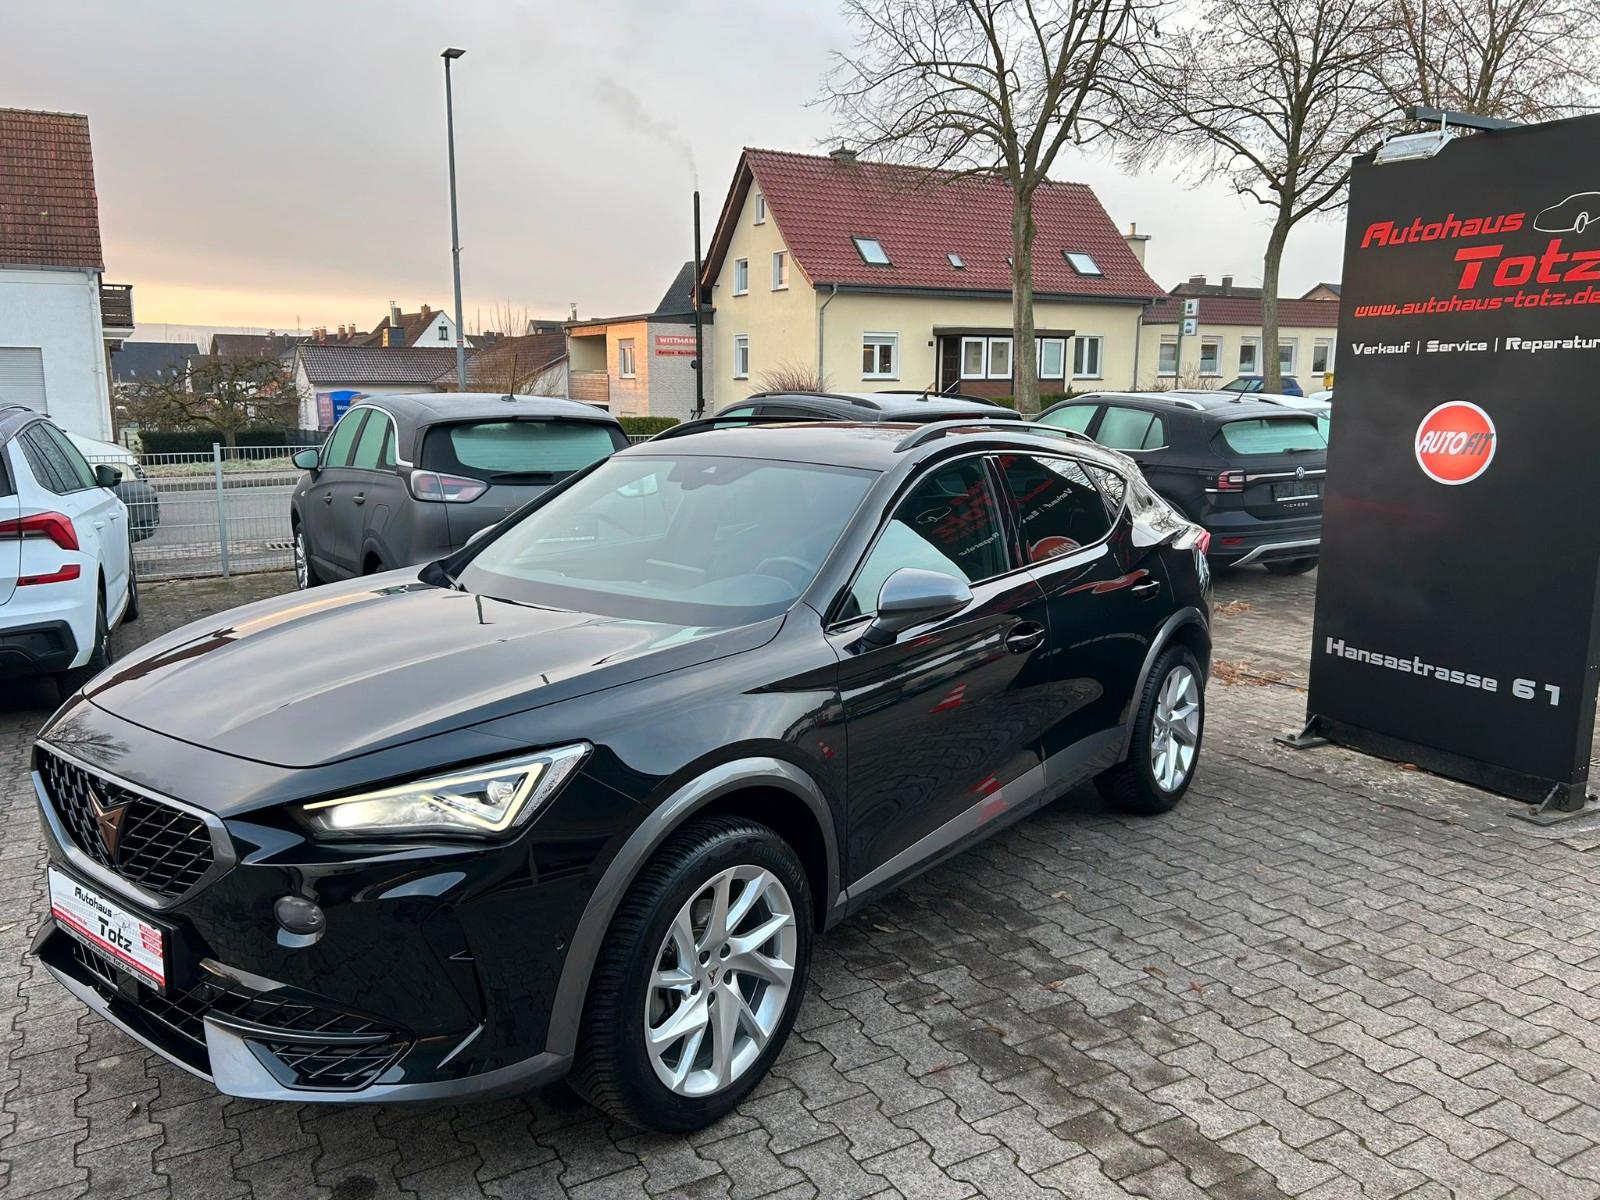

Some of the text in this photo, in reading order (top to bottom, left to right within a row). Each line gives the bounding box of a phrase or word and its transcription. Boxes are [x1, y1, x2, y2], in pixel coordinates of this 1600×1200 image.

[1361, 212, 1525, 248] Autohaus
[1454, 238, 1600, 290] Totz
[1352, 341, 1411, 355] Verkauf
[1426, 339, 1488, 353] Service
[1505, 336, 1600, 353] Reparatur
[1419, 430, 1495, 457] AUTOFIT
[1326, 636, 1498, 692] Hansastrasse
[74, 886, 112, 918] Autohaus
[98, 916, 133, 953] Totz
